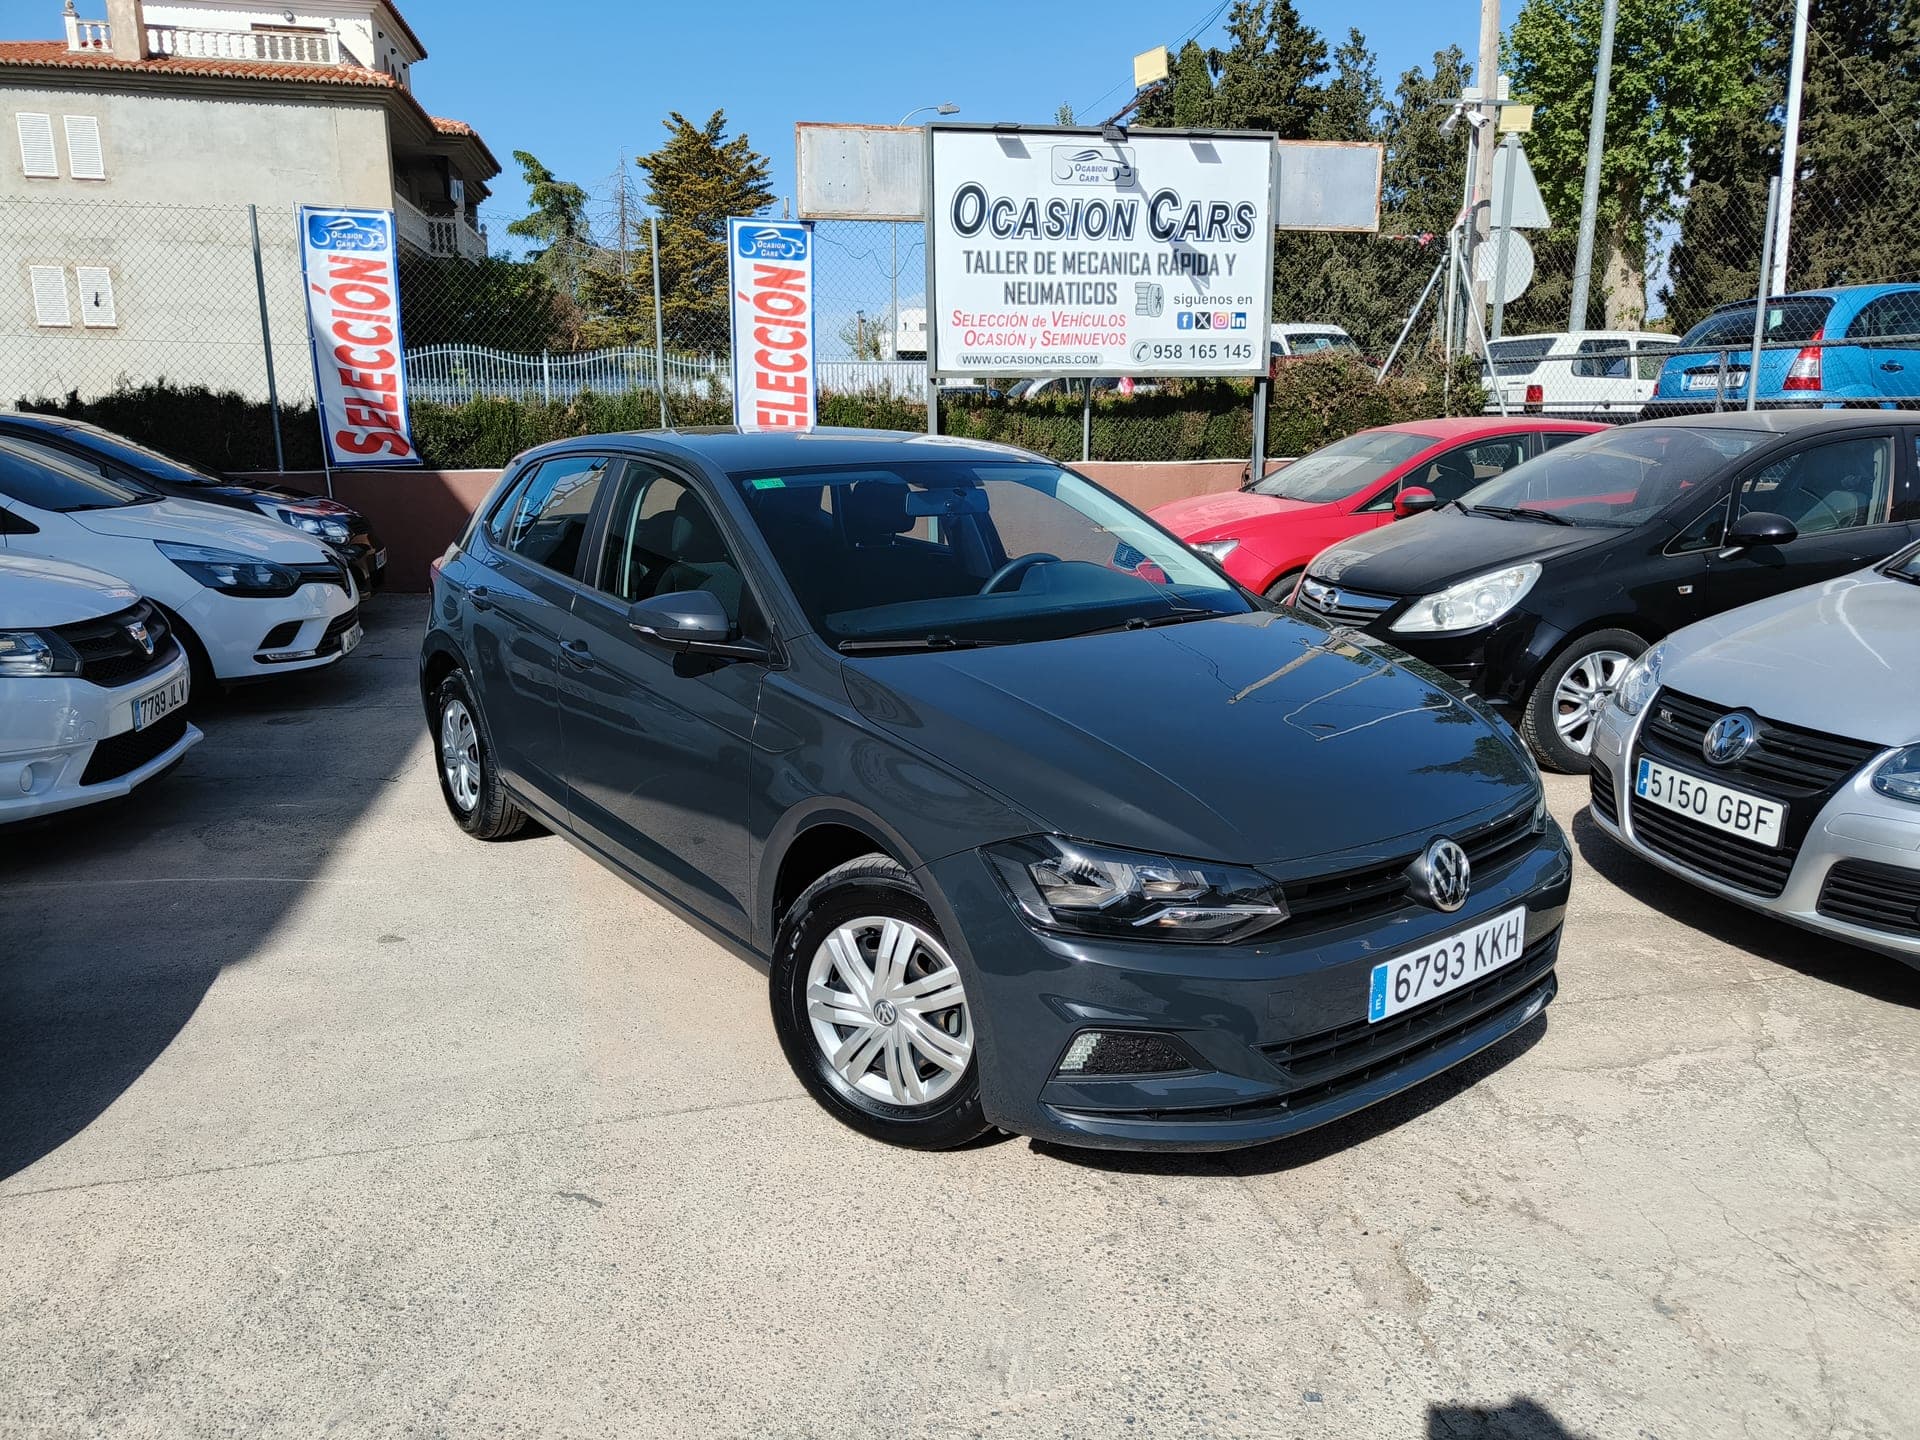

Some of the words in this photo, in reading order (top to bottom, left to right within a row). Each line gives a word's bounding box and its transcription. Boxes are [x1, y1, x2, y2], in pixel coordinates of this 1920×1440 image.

[950, 181, 1139, 240] OCASION
[1146, 187, 1257, 242] CARS
[963, 250, 1028, 275] TALLER
[1033, 250, 1057, 275] DE
[1062, 251, 1151, 276] MECANICA
[1157, 249, 1219, 276] RÁPIDA
[1225, 253, 1237, 276] Y
[1004, 281, 1118, 306] NEUMATICOS
[1237, 295, 1253, 305] en
[952, 310, 1028, 328] SELECCIÓN
[1032, 315, 1047, 328] de
[1051, 311, 1126, 328] VEHÍCULOS
[738, 263, 807, 430] ELECCIÓN
[964, 330, 1027, 347] OCASIÓN
[1030, 335, 1037, 349] y
[1040, 330, 1126, 347] SEMINUEVOS
[1153, 344, 1183, 359] 958
[1188, 344, 1217, 359] 165
[1223, 344, 1252, 359] 145
[312, 254, 410, 457] SELECCIÓN
[962, 354, 1098, 365] WWW.OCASIONCARS.COM
[141, 690, 166, 723] 7789
[169, 679, 185, 708] JLV
[1651, 769, 1708, 815] 5150
[1717, 795, 1774, 835] GBF
[1394, 941, 1466, 1003] 6793
[1474, 916, 1520, 971] KKH
